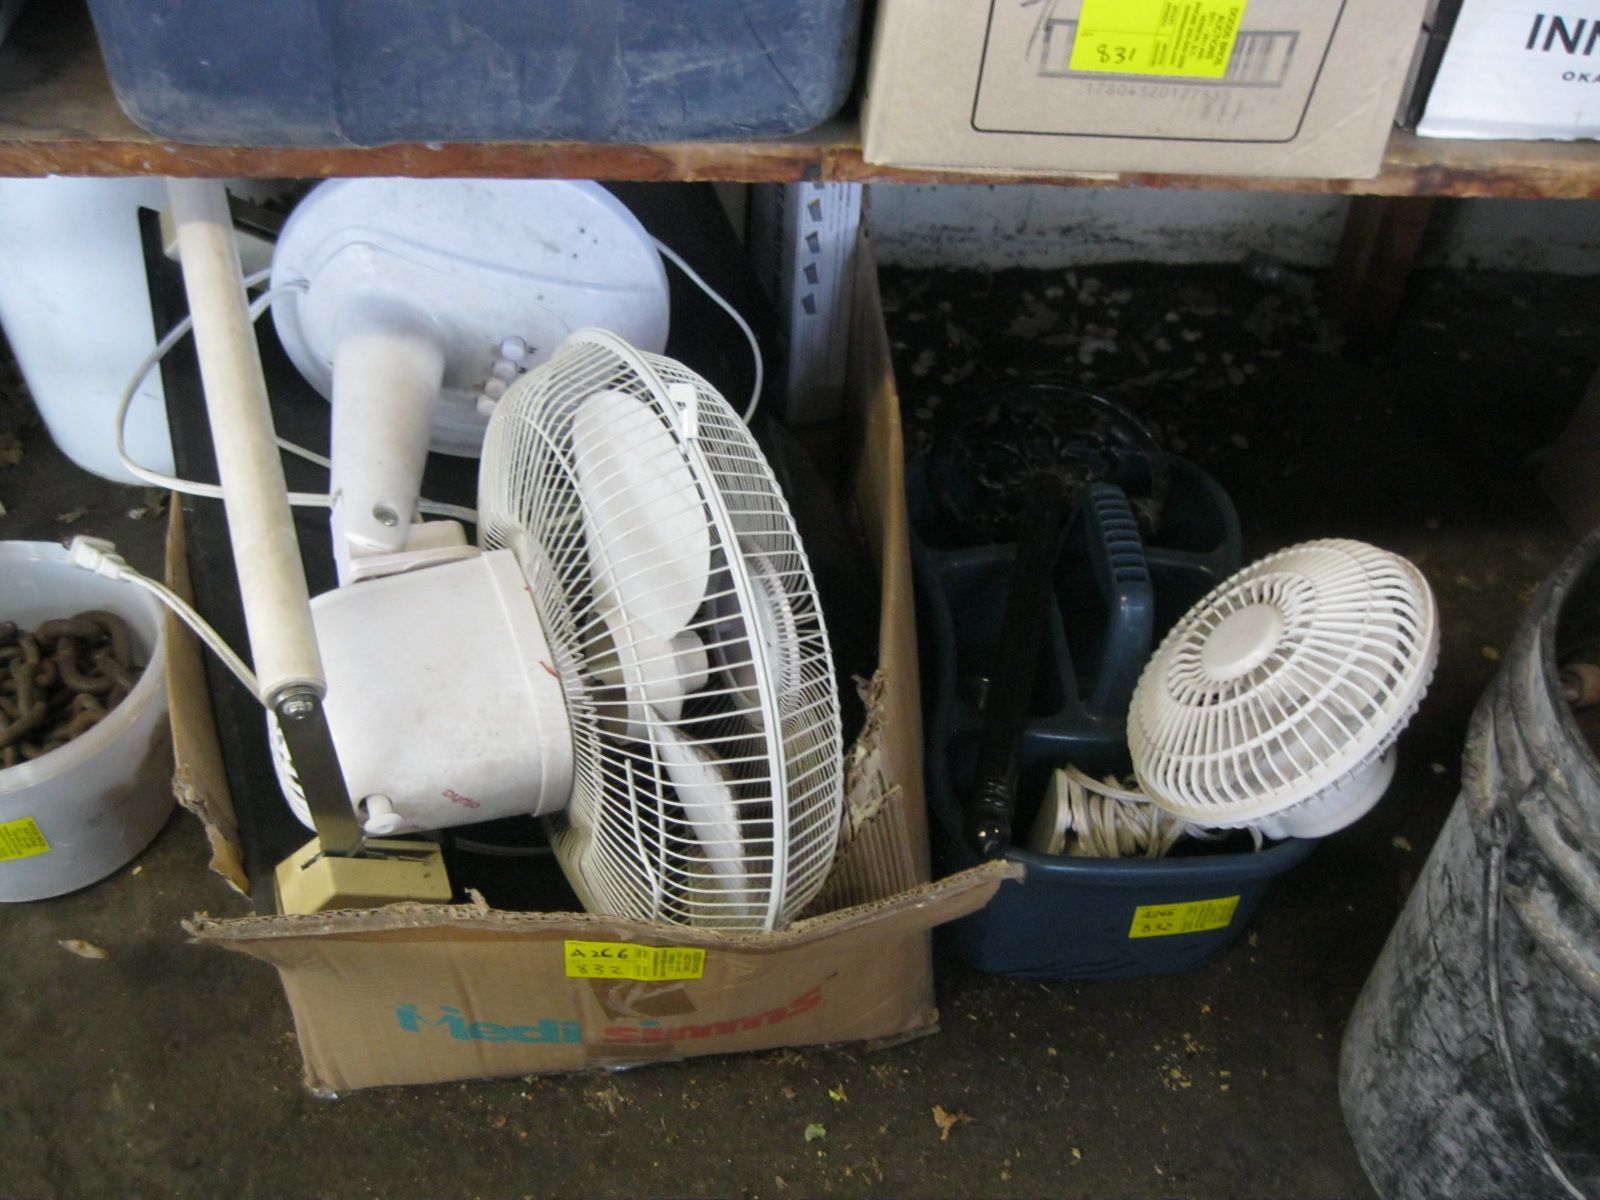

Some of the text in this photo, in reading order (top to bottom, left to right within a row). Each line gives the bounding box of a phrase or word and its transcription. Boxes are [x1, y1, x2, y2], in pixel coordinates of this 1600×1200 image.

[1096, 43, 1137, 65] 831
[575, 963, 625, 975] 832
[395, 1003, 583, 1045] Medi
